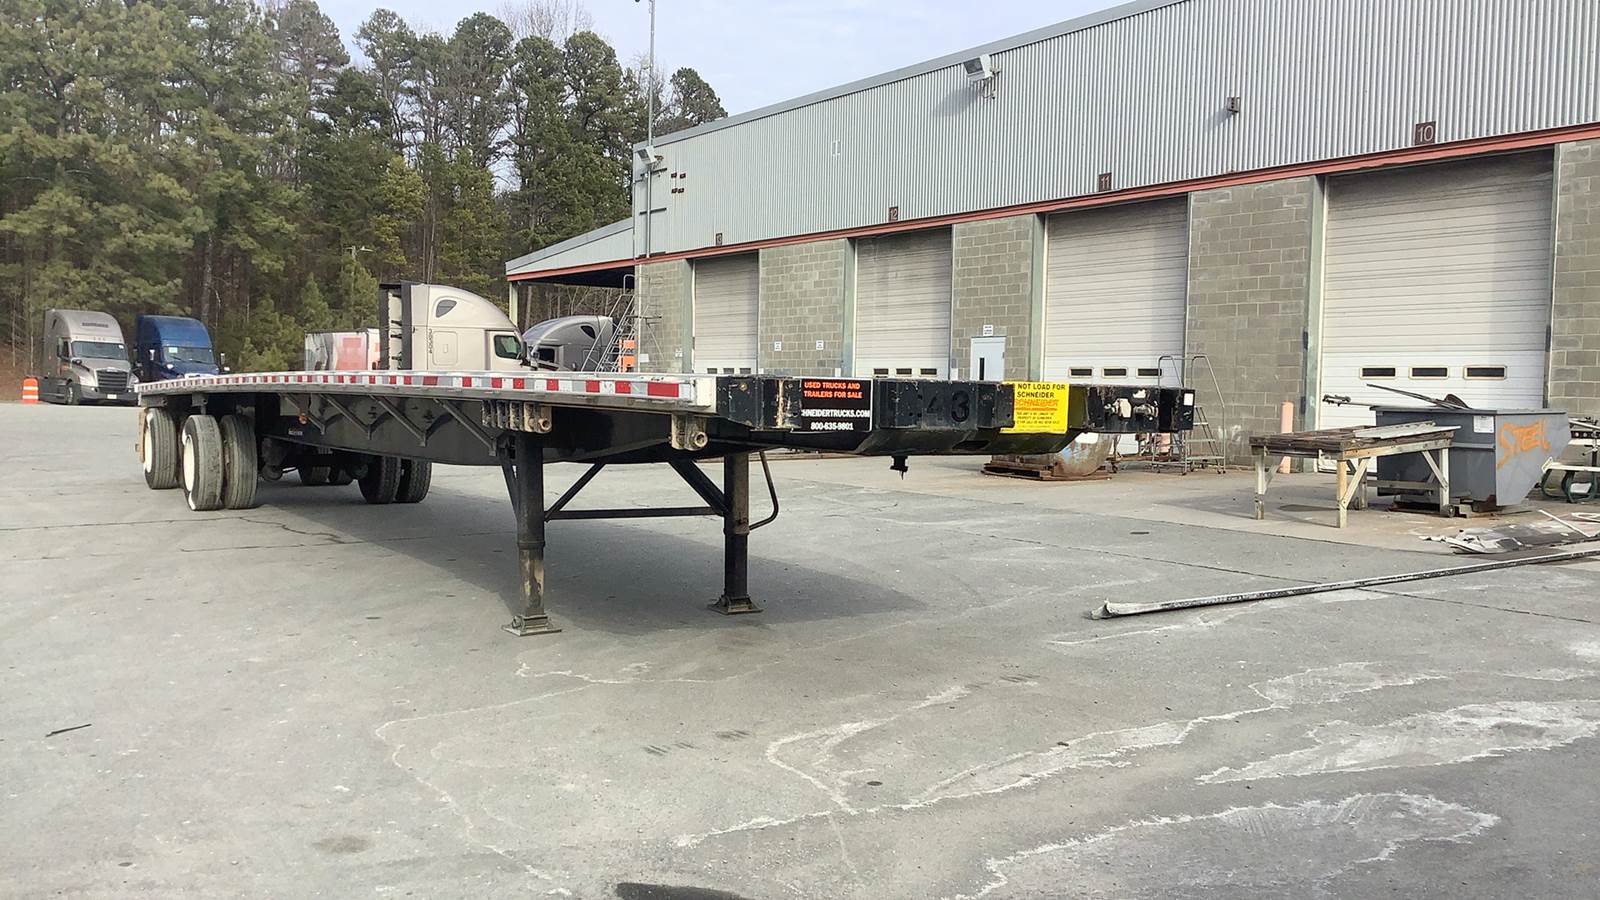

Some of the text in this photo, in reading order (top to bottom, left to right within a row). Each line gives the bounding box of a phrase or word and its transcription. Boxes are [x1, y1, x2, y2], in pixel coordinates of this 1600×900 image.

[1418, 125, 1434, 142] 10
[1101, 176, 1109, 189] 11
[891, 208, 898, 220] 12
[804, 381, 821, 389] USED
[1033, 383, 1051, 391] LOAD
[1052, 383, 1066, 391] FOR
[803, 390, 833, 398] TRAILERS
